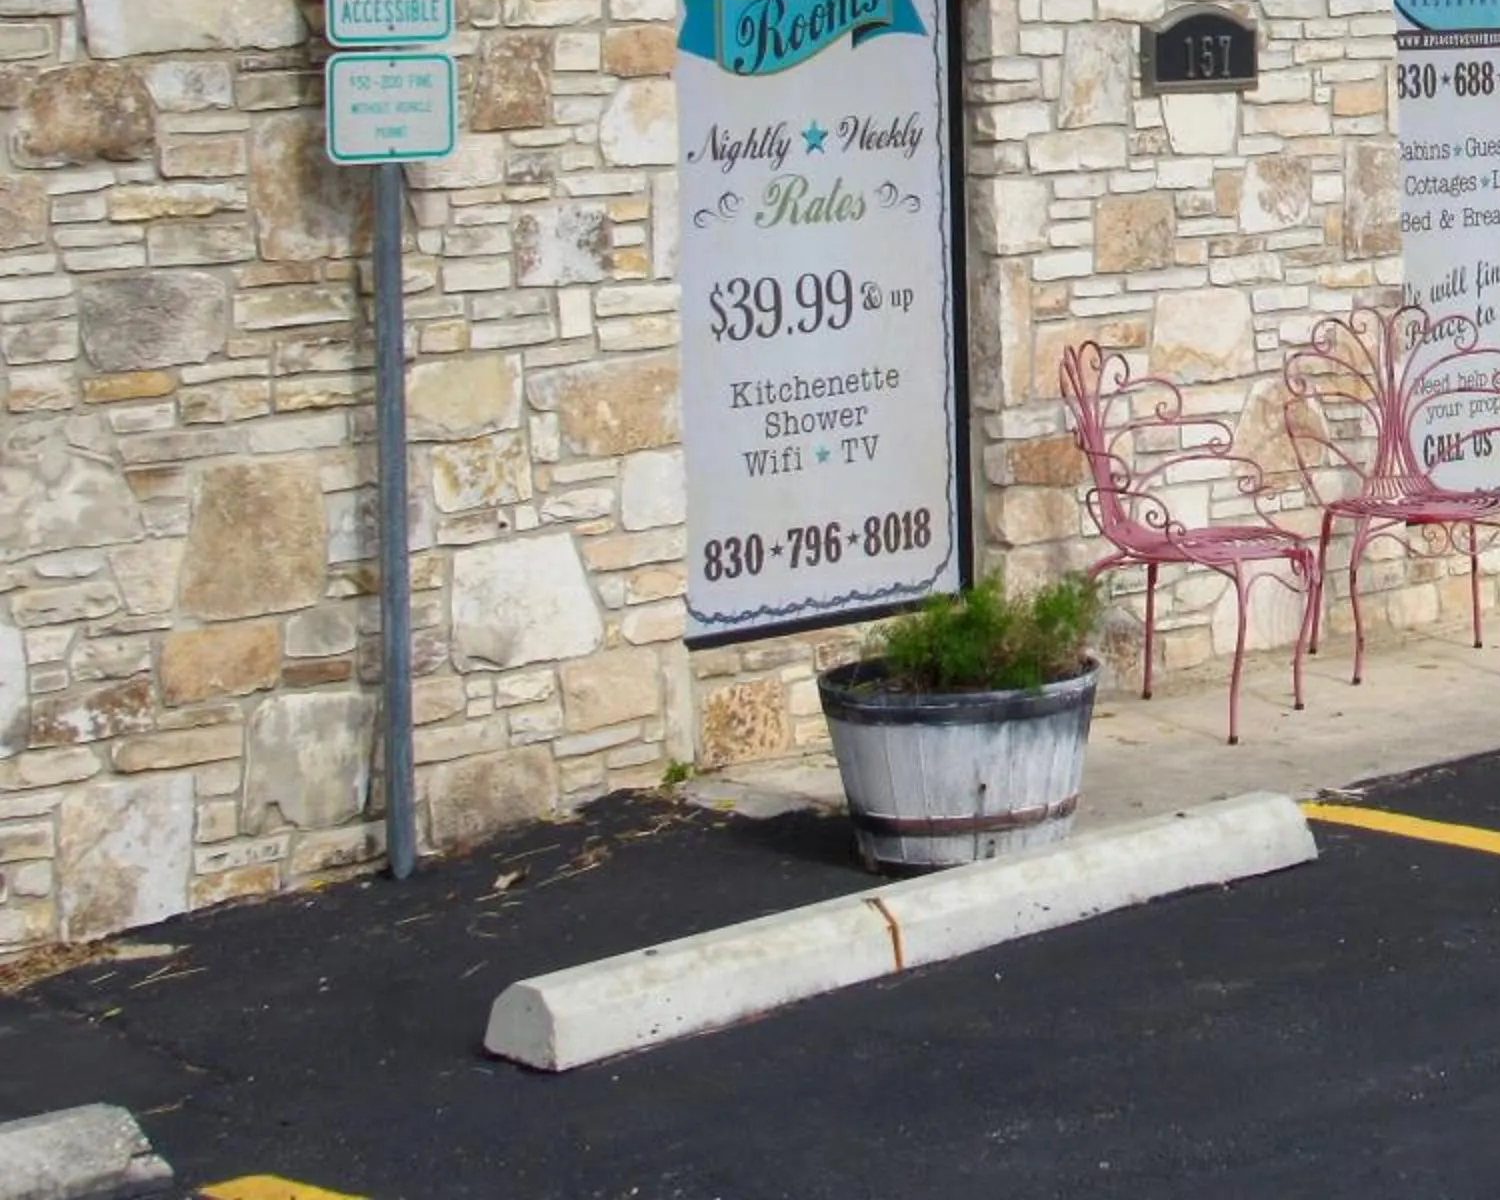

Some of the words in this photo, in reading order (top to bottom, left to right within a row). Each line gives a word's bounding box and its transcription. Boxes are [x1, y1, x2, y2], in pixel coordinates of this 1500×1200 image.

[341, 0, 440, 24] ACCESSIBLE
[1183, 35, 1233, 78] 157
[687, 120, 793, 174] Nightly
[836, 111, 926, 159] Weekly
[754, 173, 868, 229] Rates
[1405, 175, 1477, 197] Cottages
[1400, 211, 1432, 233] Bed
[1439, 209, 1455, 230] &
[1430, 265, 1468, 303] will
[709, 269, 854, 342] $39.99
[890, 286, 914, 313] up
[1476, 306, 1496, 328] to
[729, 367, 900, 409] Kitchenette
[765, 404, 868, 439] Shower
[1426, 401, 1463, 425] your
[743, 446, 803, 478] Wifi
[841, 435, 880, 463] TV
[1423, 432, 1465, 468] CALL
[1472, 430, 1493, 457] US
